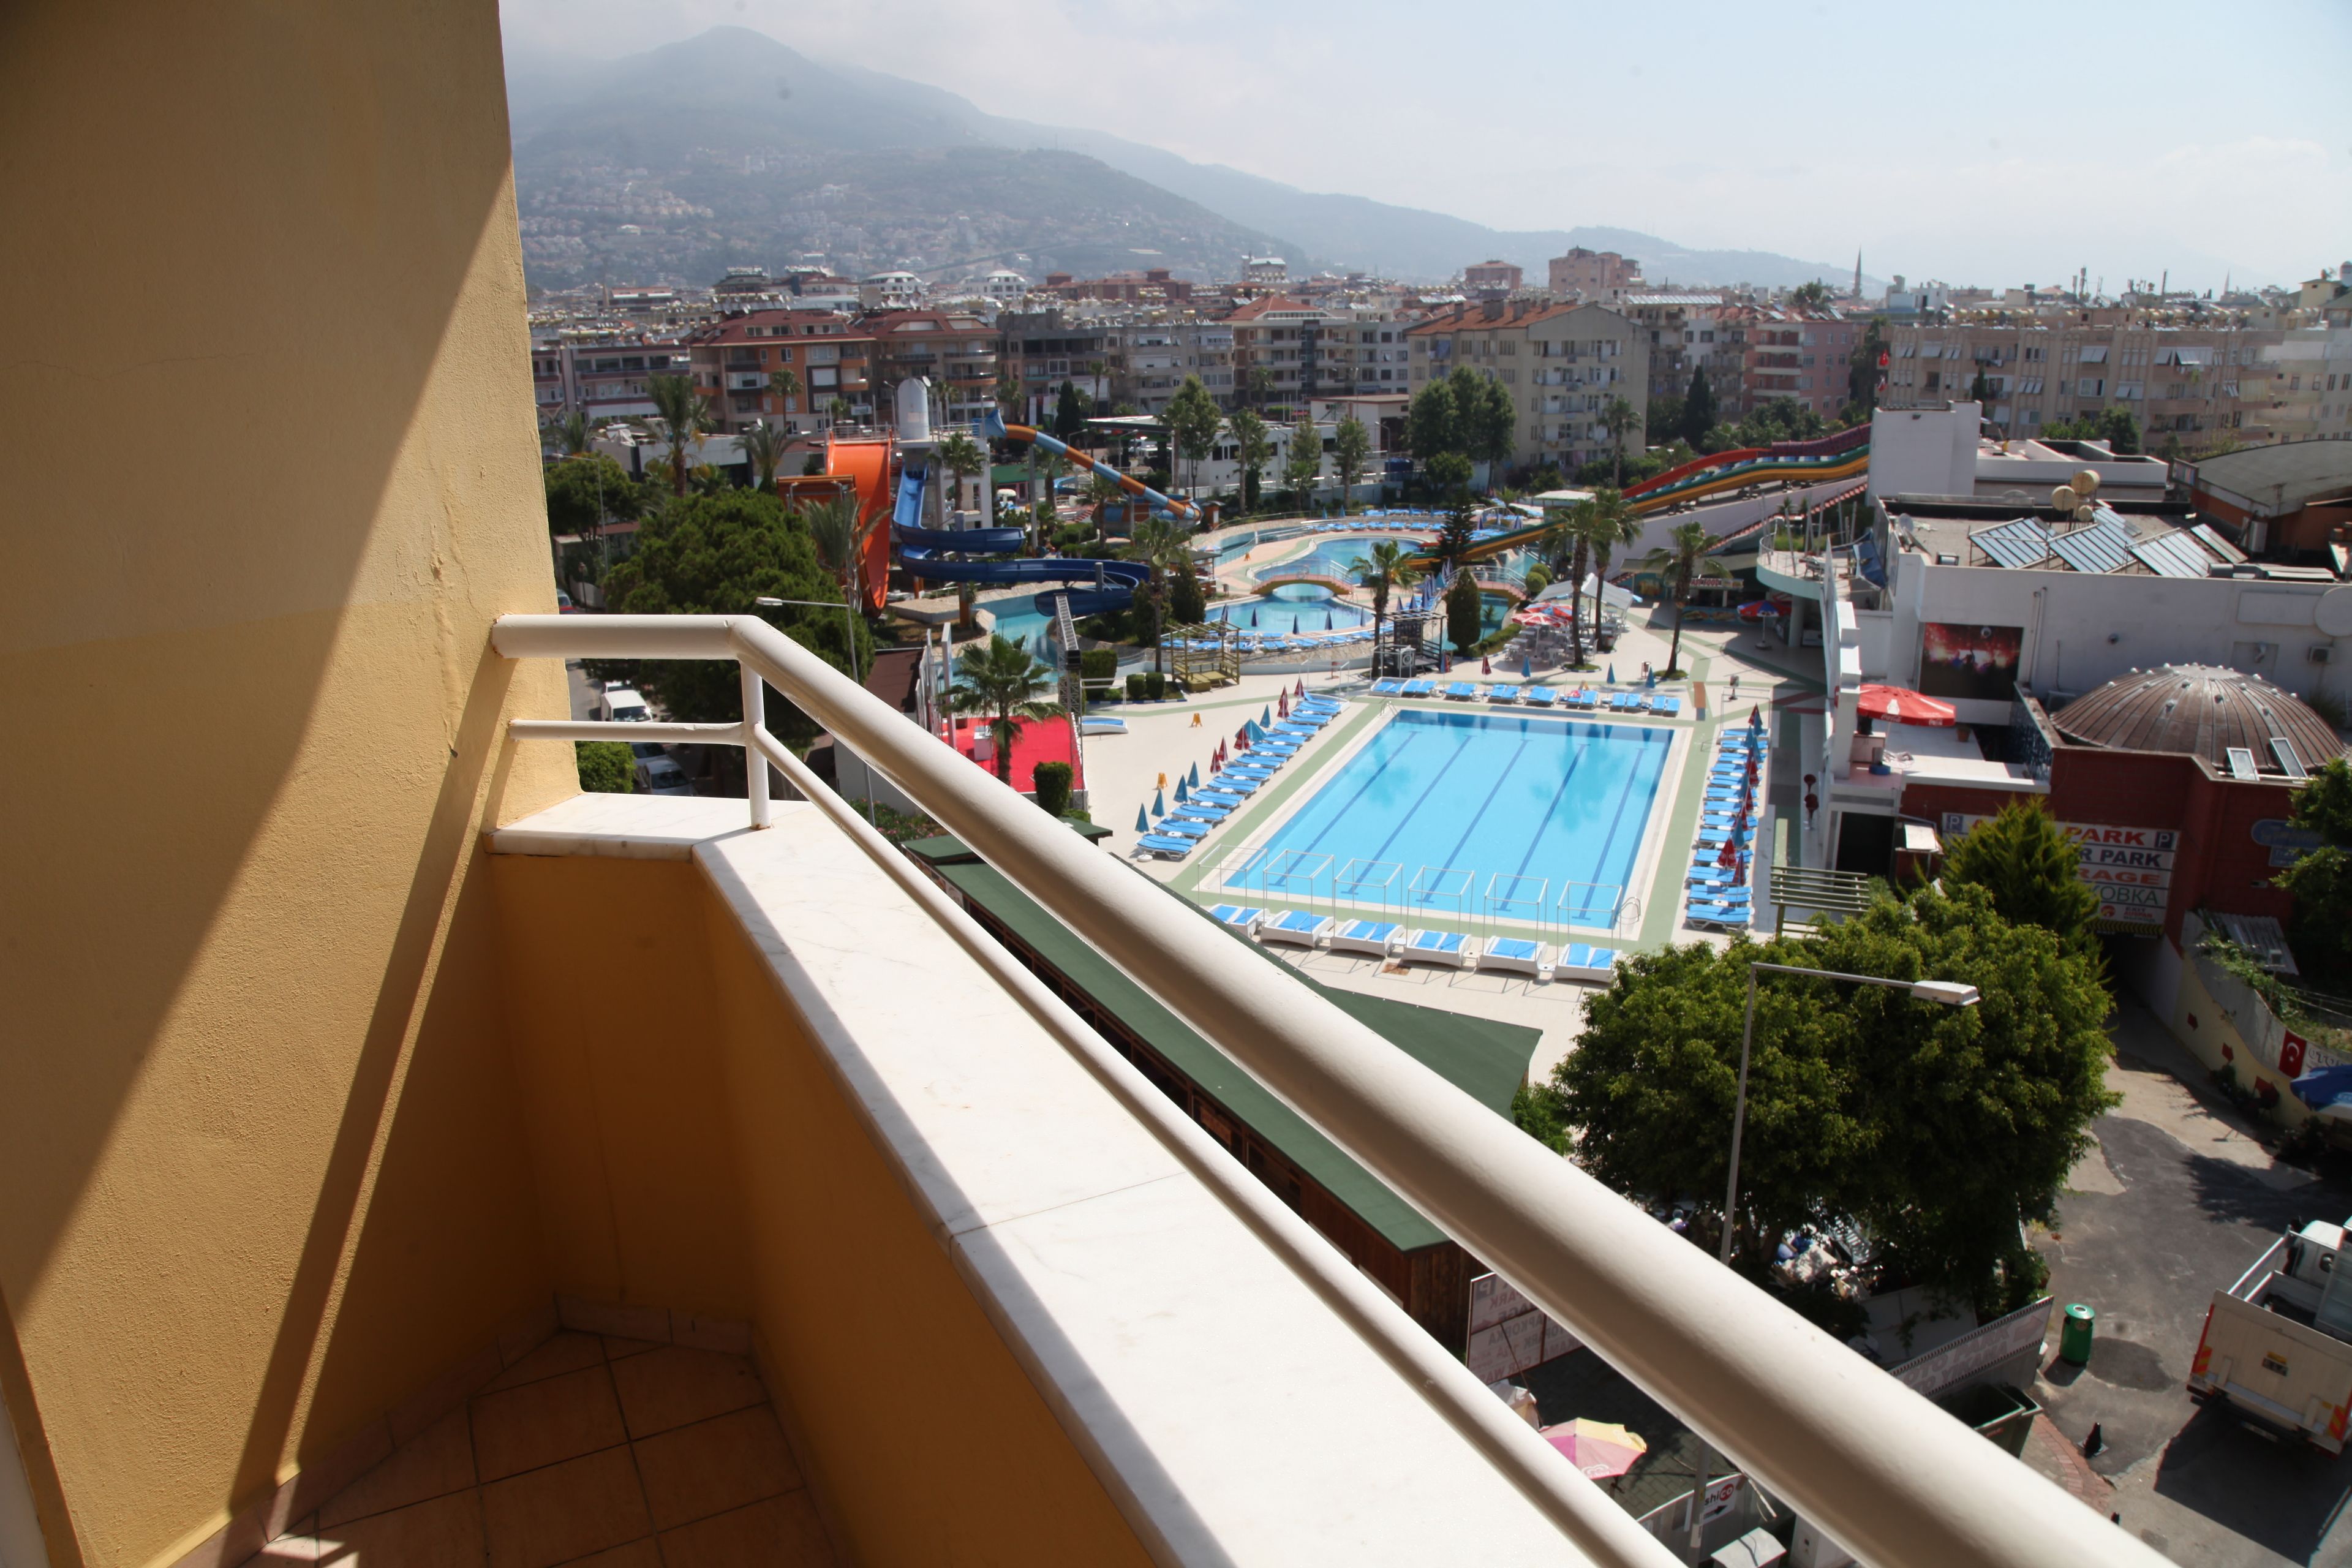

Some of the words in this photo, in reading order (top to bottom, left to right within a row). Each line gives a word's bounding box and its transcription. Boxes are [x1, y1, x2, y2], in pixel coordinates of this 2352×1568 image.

[2065, 827, 2146, 846] PARK
[2158, 833, 2171, 847] P
[2079, 848, 2093, 861] R
[2100, 850, 2163, 867] PARK
[2078, 869, 2162, 886] RAGE
[1705, 1486, 1734, 1506] shico
